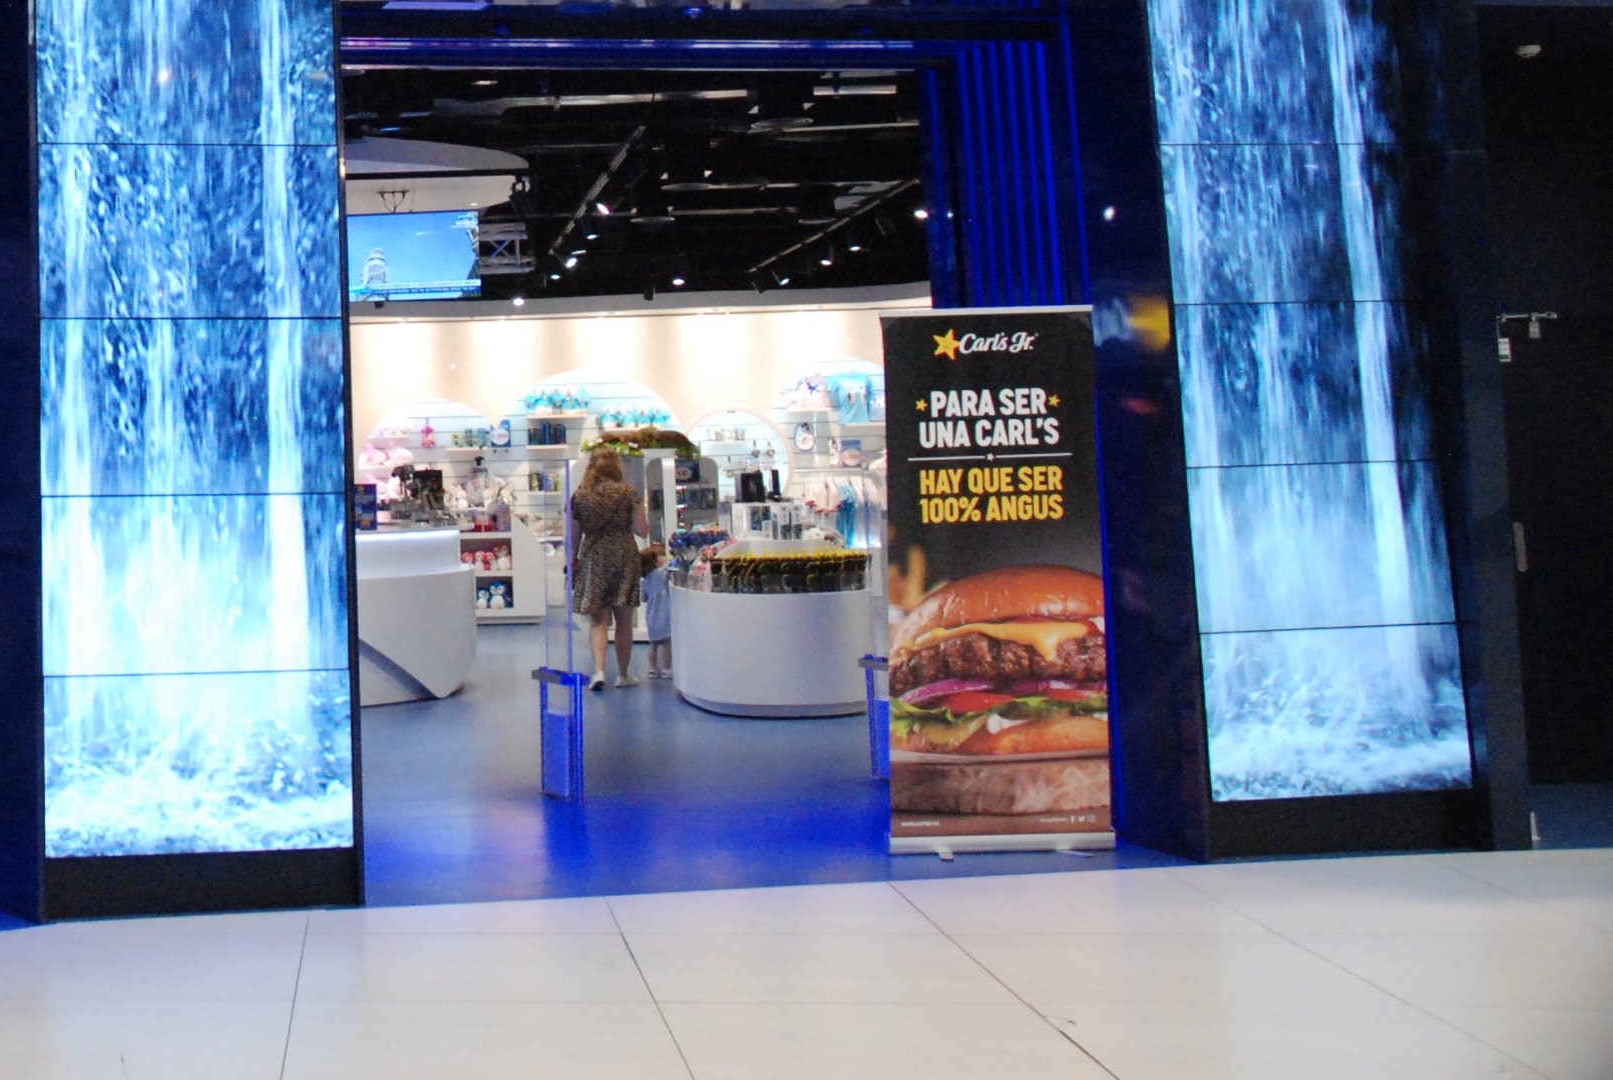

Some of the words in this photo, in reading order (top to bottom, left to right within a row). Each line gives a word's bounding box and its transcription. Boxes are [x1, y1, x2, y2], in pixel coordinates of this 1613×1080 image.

[958, 331, 1008, 354] Carl's
[1008, 331, 1034, 353] Jr.
[930, 389, 996, 418] PARA
[998, 387, 1047, 416] SER
[919, 420, 971, 448] UNA
[975, 417, 1060, 447] CARL'S
[920, 468, 964, 495] HAY
[967, 467, 1014, 495] QUE
[1018, 465, 1063, 492] SER
[919, 496, 982, 524] 100%
[986, 494, 1064, 522] ANGUS
